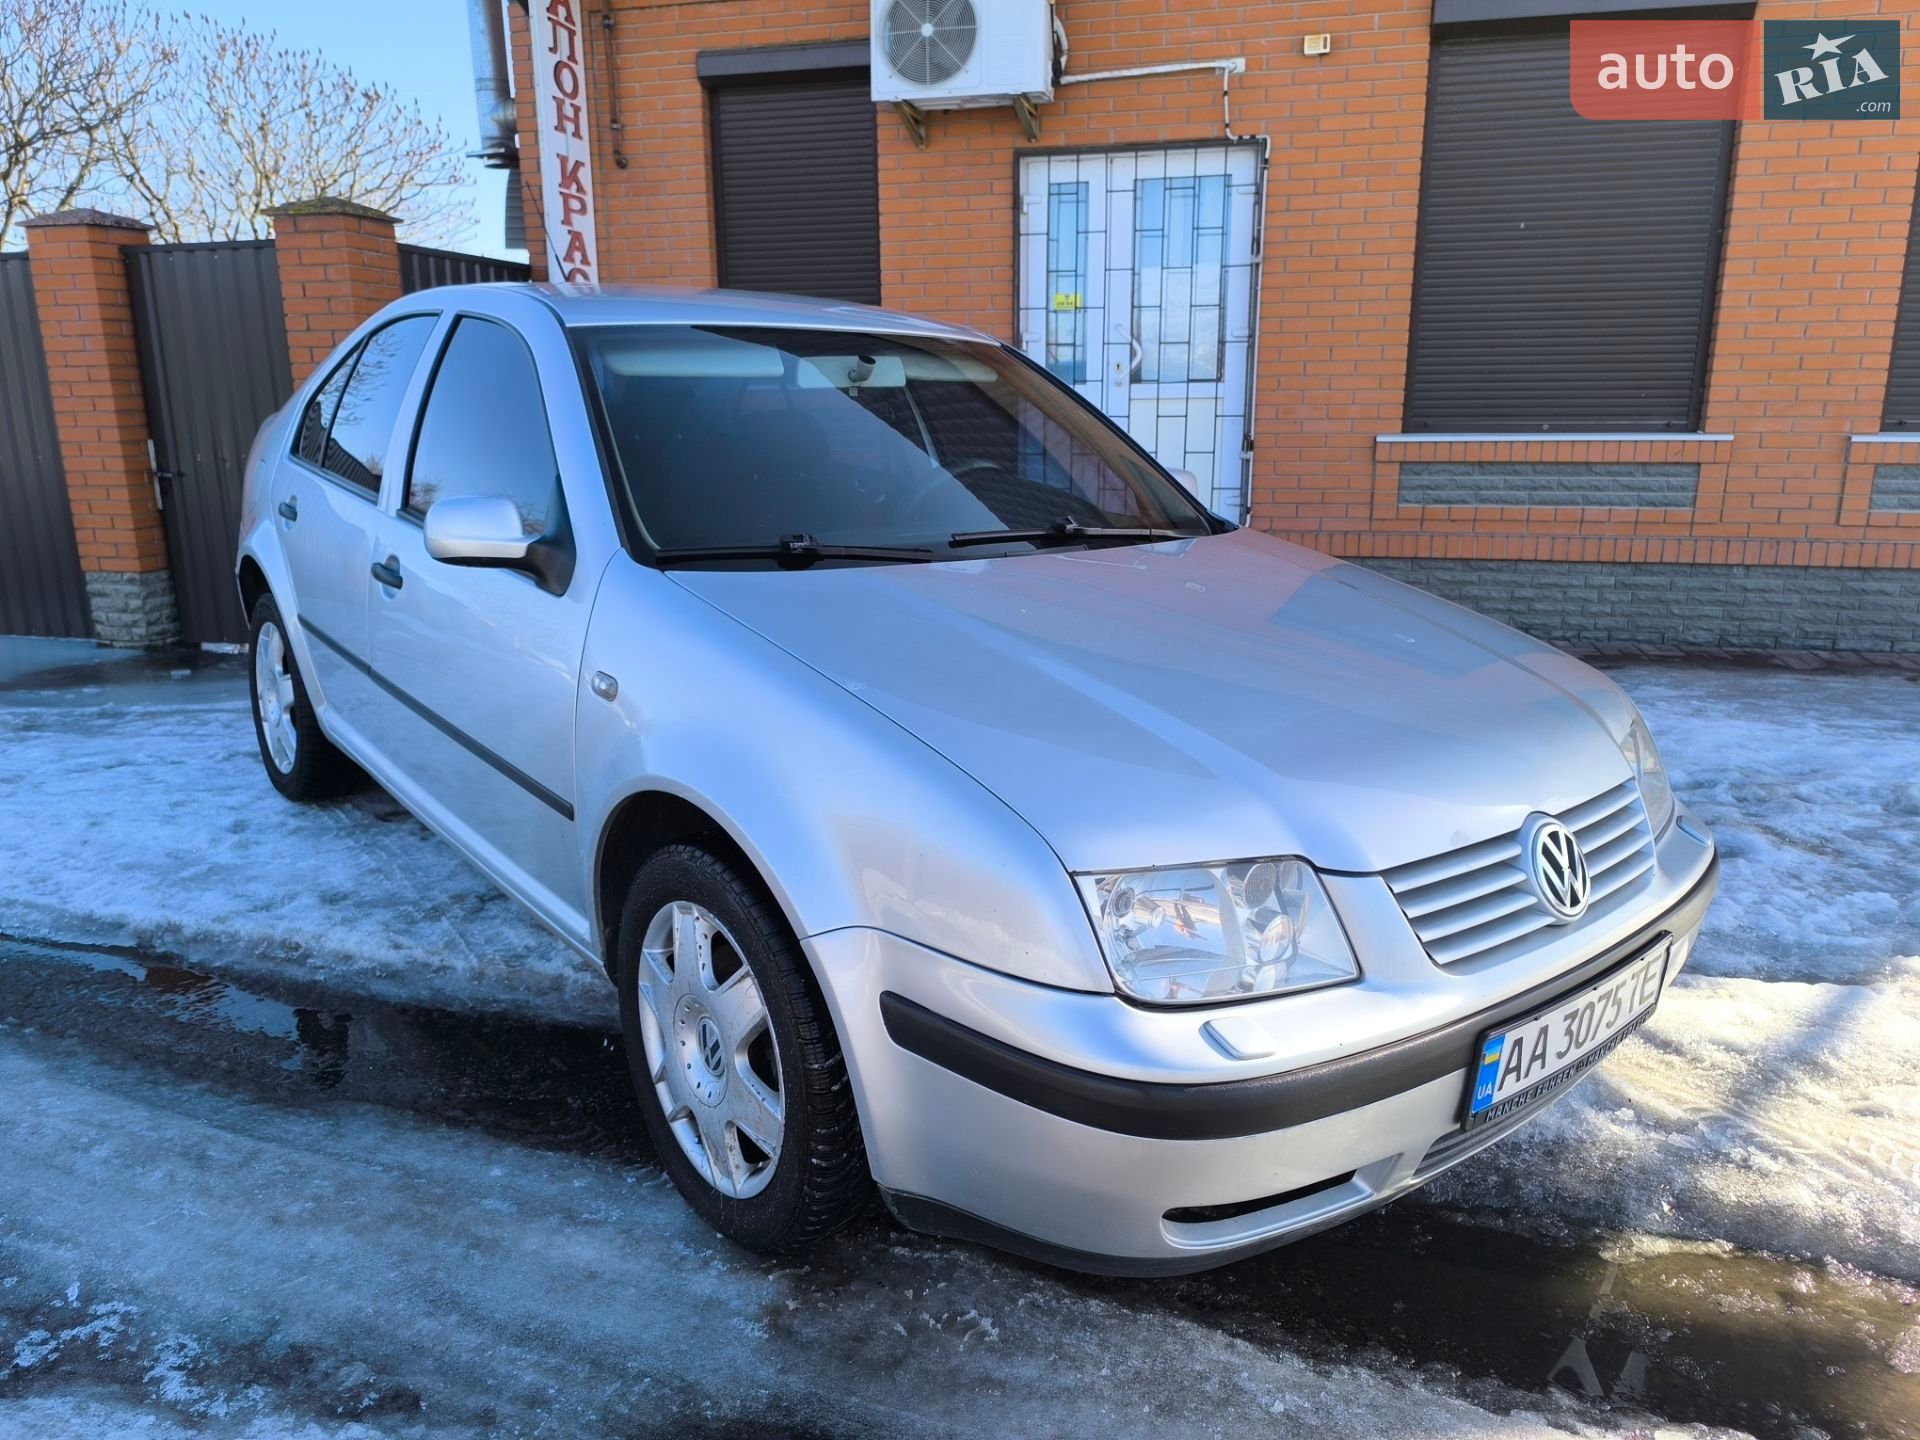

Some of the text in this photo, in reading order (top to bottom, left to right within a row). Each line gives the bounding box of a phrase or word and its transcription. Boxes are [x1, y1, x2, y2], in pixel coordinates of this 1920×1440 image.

[1497, 1024, 1550, 1092] AA
[1556, 983, 1627, 1060] 3075
[1628, 954, 1663, 1014] TE
[1477, 1081, 1492, 1100] UA
